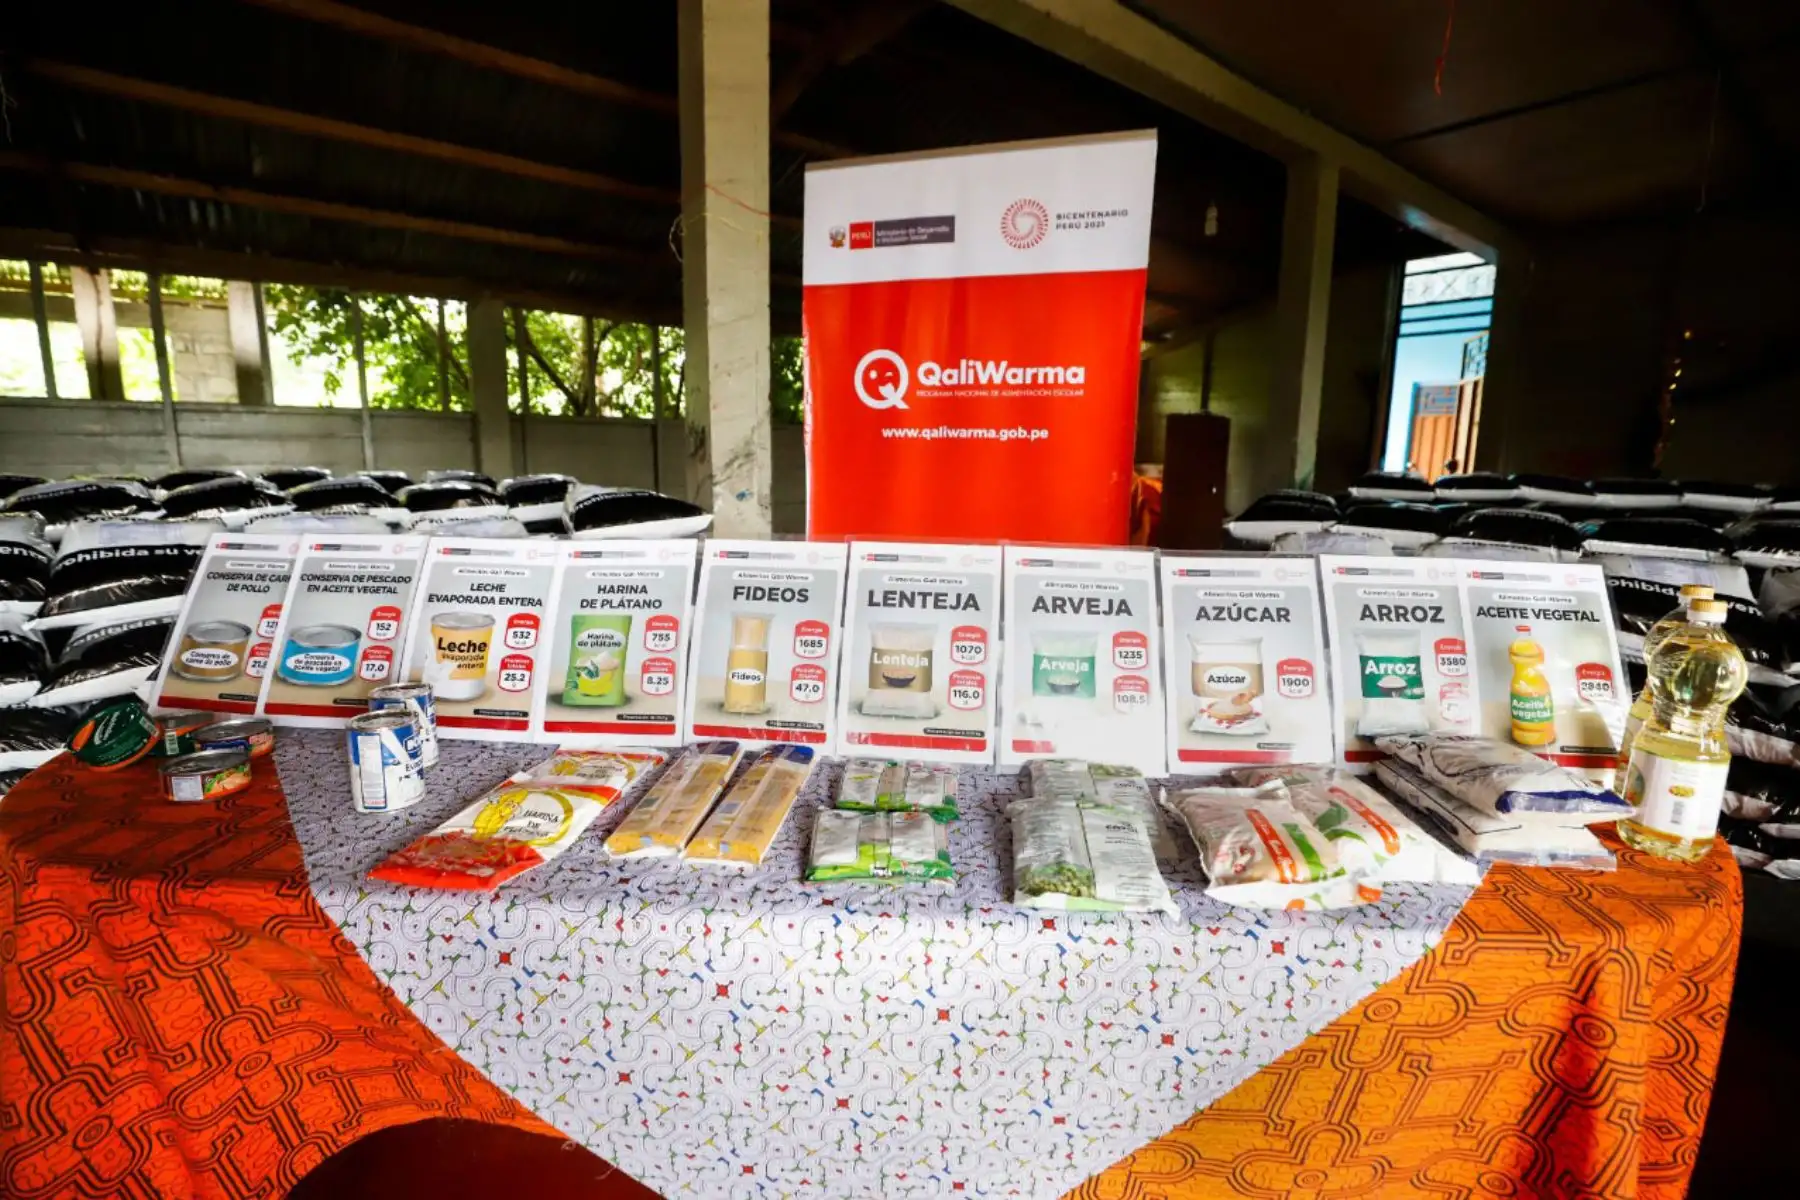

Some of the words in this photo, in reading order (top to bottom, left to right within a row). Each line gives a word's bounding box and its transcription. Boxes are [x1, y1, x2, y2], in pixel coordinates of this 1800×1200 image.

[1056, 209, 1129, 220] BICENTENARIO
[917, 359, 1085, 386] QaliWarma
[881, 425, 1049, 441] www.qaliwarma.gob.pe
[55, 548, 150, 570] rohibida
[207, 571, 253, 581] CONSERVA
[255, 573, 268, 582] DE
[268, 575, 291, 583] CAR
[300, 573, 350, 583] CONSERVA
[352, 575, 365, 583] DE
[366, 575, 412, 584] PESCADO
[227, 583, 240, 592] DE
[240, 584, 270, 593] POLLO
[307, 584, 321, 593] EN
[321, 585, 355, 594] ACEITE
[357, 585, 399, 594] VEGETAL
[470, 583, 507, 593] LECHE
[597, 584, 648, 595] HARINA
[1607, 579, 1681, 597] ohibid
[733, 586, 809, 603] FIDEOS
[428, 593, 496, 605] EVAPORADA
[499, 597, 543, 607] ENTERA
[580, 598, 599, 609] DE
[600, 596, 663, 610] PLÁTANO
[867, 589, 981, 611] LENTEJA
[1032, 595, 1133, 617] ARVEJA
[1196, 602, 1291, 623] AZÚCAR
[1360, 604, 1445, 624] ARROZ
[1476, 606, 1529, 619] ACEITE
[1531, 608, 1600, 622] VEGETAL
[376, 622, 392, 631] 152
[512, 631, 531, 640] 532
[652, 632, 671, 642] 755
[437, 637, 488, 653] Leche
[799, 639, 823, 648] 1685
[955, 645, 982, 654] 1070
[873, 652, 929, 668] Lenteja
[1118, 650, 1143, 660] 1235
[1040, 657, 1089, 673] Arveja
[1439, 656, 1467, 666] 3580
[365, 663, 385, 672] 17.0
[1365, 660, 1416, 675] Arroz
[504, 673, 526, 682] 25.2
[646, 676, 669, 685] 8.25
[731, 672, 761, 681] Fideos
[1207, 674, 1246, 684] Azúcar
[1282, 677, 1309, 687] 1900
[795, 683, 820, 693] 47.0
[953, 689, 980, 699] 116.0
[1117, 695, 1146, 704] 108.5
[1512, 699, 1545, 708] Aceite
[1512, 709, 1551, 719] vegetal
